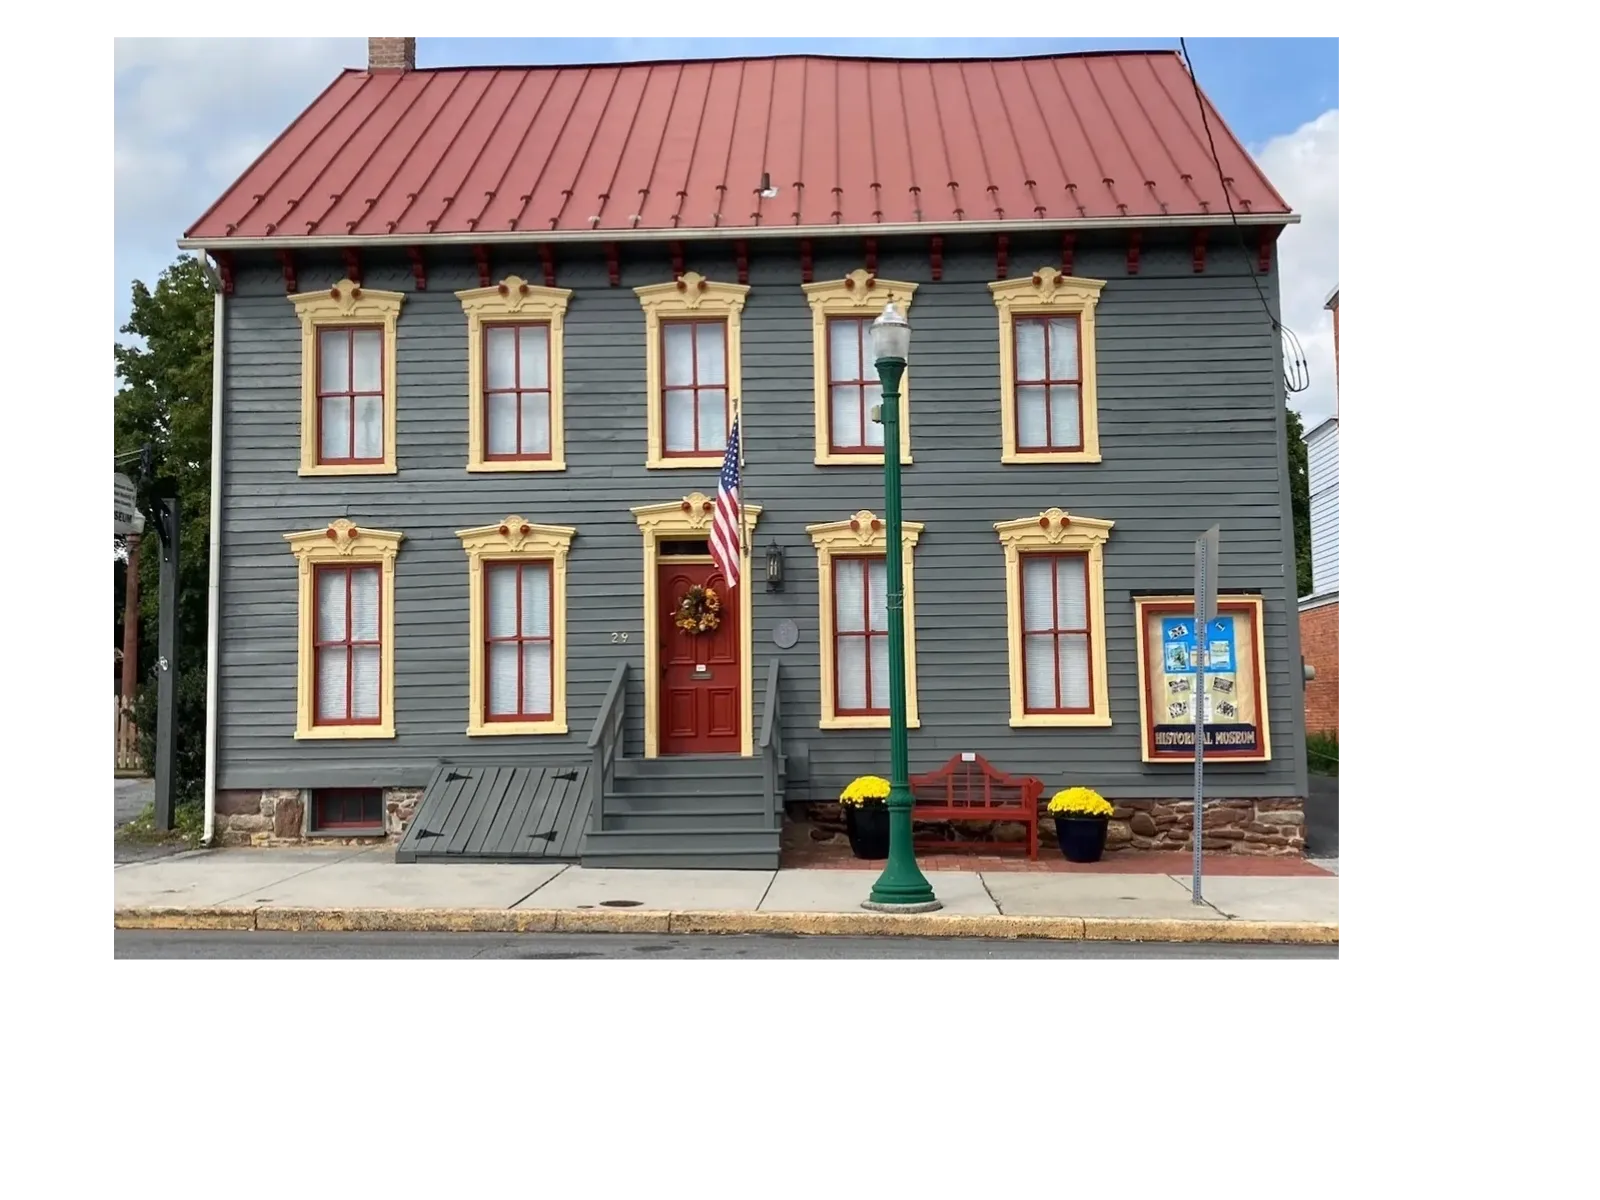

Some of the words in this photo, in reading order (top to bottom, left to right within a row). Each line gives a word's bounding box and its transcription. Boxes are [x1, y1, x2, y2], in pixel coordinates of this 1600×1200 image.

[611, 632, 629, 643] 29
[1155, 731, 1213, 745] HISTORIAL
[1215, 731, 1256, 745] MUSEUM
